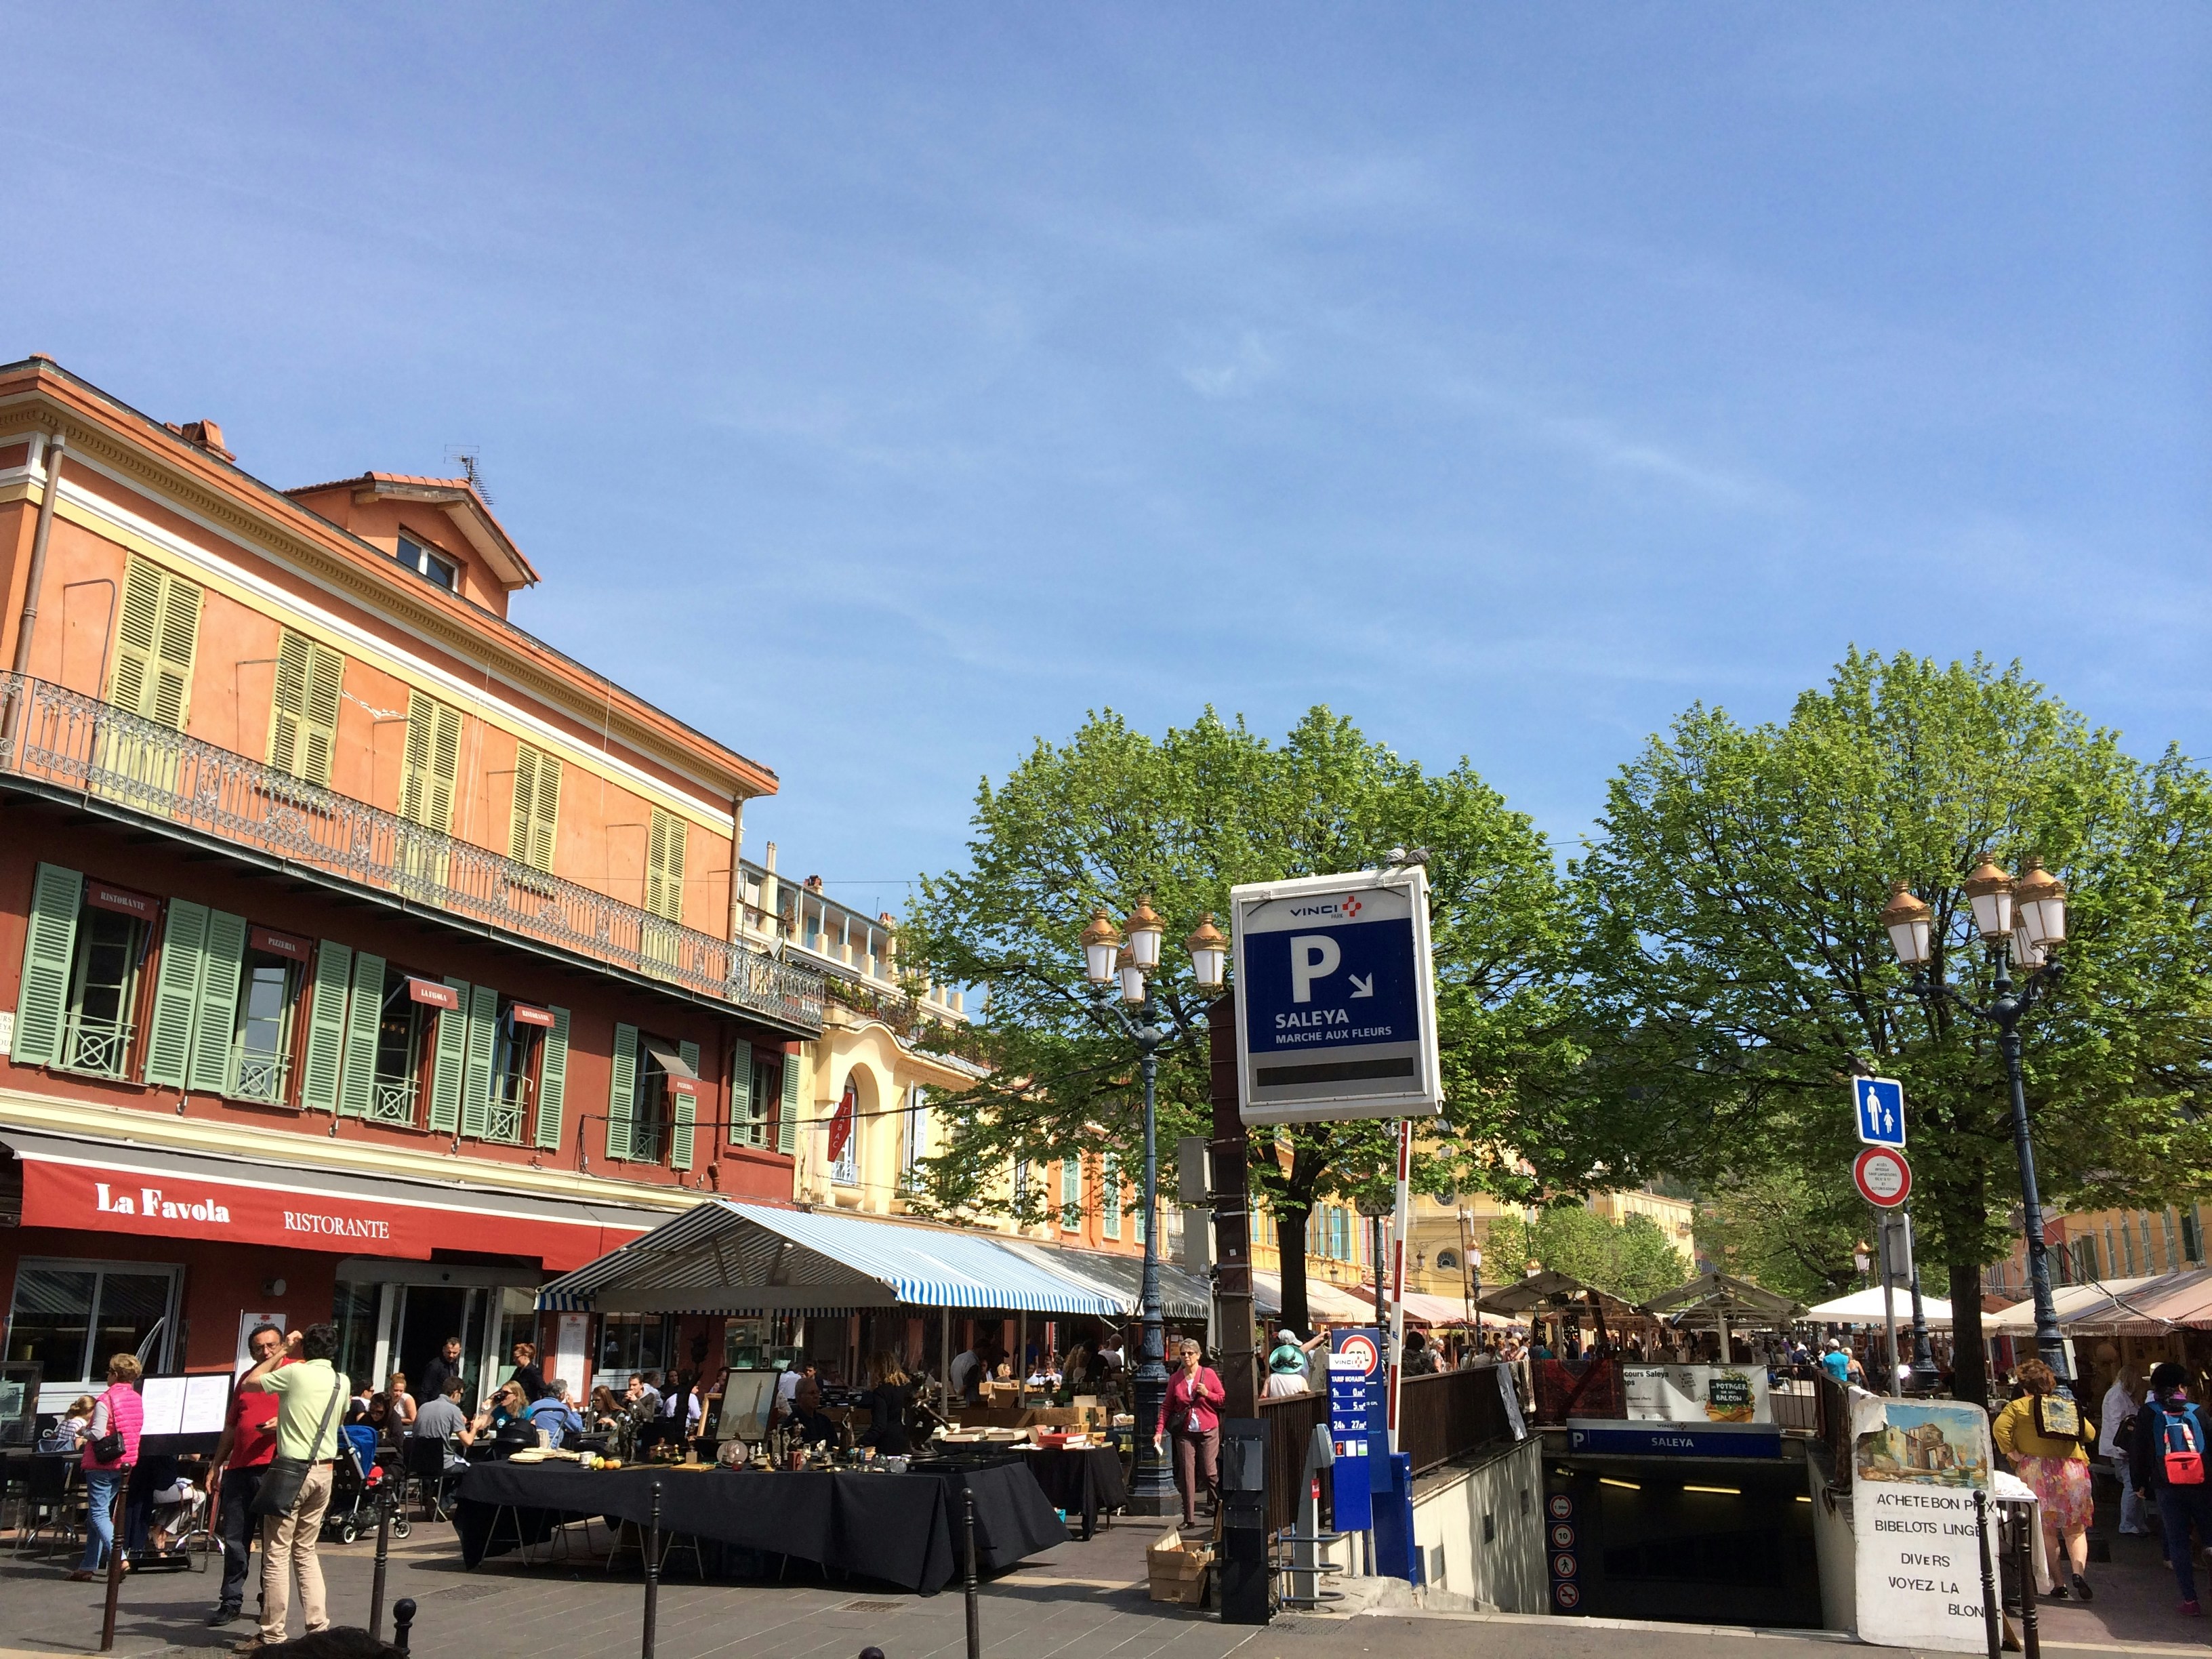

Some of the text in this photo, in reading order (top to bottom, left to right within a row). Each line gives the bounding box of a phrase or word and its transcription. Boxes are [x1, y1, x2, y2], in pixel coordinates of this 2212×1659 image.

[100, 892, 145, 911] RISTORANTE
[1290, 904, 1337, 917] VINCI
[268, 937, 295, 951] PIZZERIA
[1290, 935, 1341, 1003] P
[1275, 1008, 1349, 1029] SALEYA
[1326, 1029, 1349, 1040] AUX
[1352, 1026, 1392, 1038] FLEURS
[833, 1107, 848, 1148] TABAC
[95, 1183, 230, 1223] La Favola
[283, 1211, 390, 1239] RISTORANTE
[1646, 1370, 1669, 1379] Saleya
[1332, 1388, 1339, 1396] 1h
[1332, 1401, 1340, 1410] 2h
[1334, 1420, 1345, 1429] 24h
[1572, 1432, 1694, 1448] P SALEYA
[1931, 1497, 1959, 1509] BON
[1964, 1500, 1994, 1513] PX
[1875, 1520, 1937, 1534] BIBELOTS
[1901, 1553, 1950, 1568] DIVERS
[1888, 1576, 1960, 1594] VOYEZ LA
[1948, 1603, 2001, 1620] BLON
